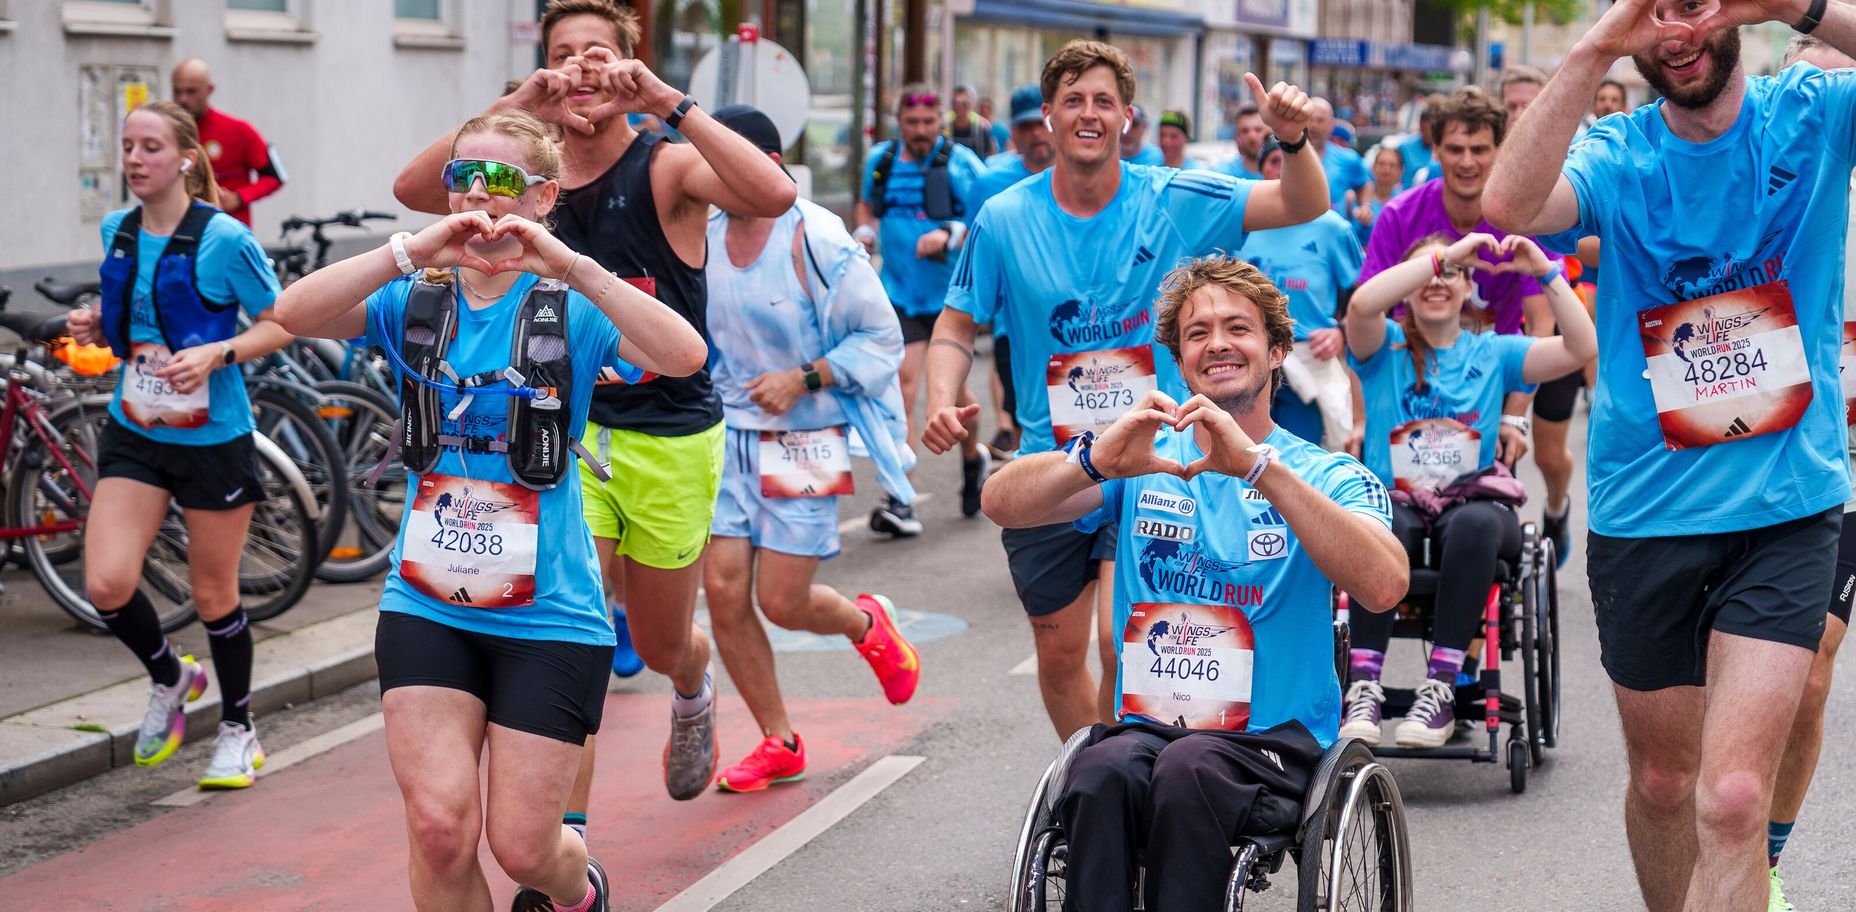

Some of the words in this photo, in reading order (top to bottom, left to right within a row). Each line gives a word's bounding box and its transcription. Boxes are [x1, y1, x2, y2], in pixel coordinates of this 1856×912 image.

[1067, 307, 1151, 344] WORLDRUN
[1696, 315, 1742, 335] WINGS
[1706, 330, 1731, 345] LIFE
[1690, 343, 1732, 359] WORLDRUN
[1732, 338, 1751, 351] 2025
[1684, 348, 1768, 386] 48284
[1695, 377, 1758, 401] MARTIN
[1074, 389, 1134, 410] 46273
[541, 427, 550, 467] AONIJIE
[781, 444, 831, 461] 47115
[1411, 450, 1462, 465] 42365
[453, 497, 494, 512] WINGS
[1140, 493, 1176, 509] Allianz
[457, 510, 480, 521] LIFE
[444, 518, 476, 531] WORLDRUN
[477, 523, 494, 532] 2025
[1138, 520, 1194, 541] RADO
[431, 528, 503, 556] 42038
[1178, 551, 1221, 571] WINGS
[447, 564, 480, 576] Juliane
[502, 582, 513, 598] 2
[1158, 568, 1264, 607] WORLDRUN
[1840, 574, 1856, 602] FUSION
[1171, 624, 1211, 637] WINGS
[1176, 636, 1200, 646] LIFE
[1160, 645, 1196, 656] WORLDRUN
[1197, 648, 1212, 657] 2025
[1150, 656, 1220, 682] 44046
[1172, 691, 1191, 702] Nico
[1218, 710, 1226, 726] 1
